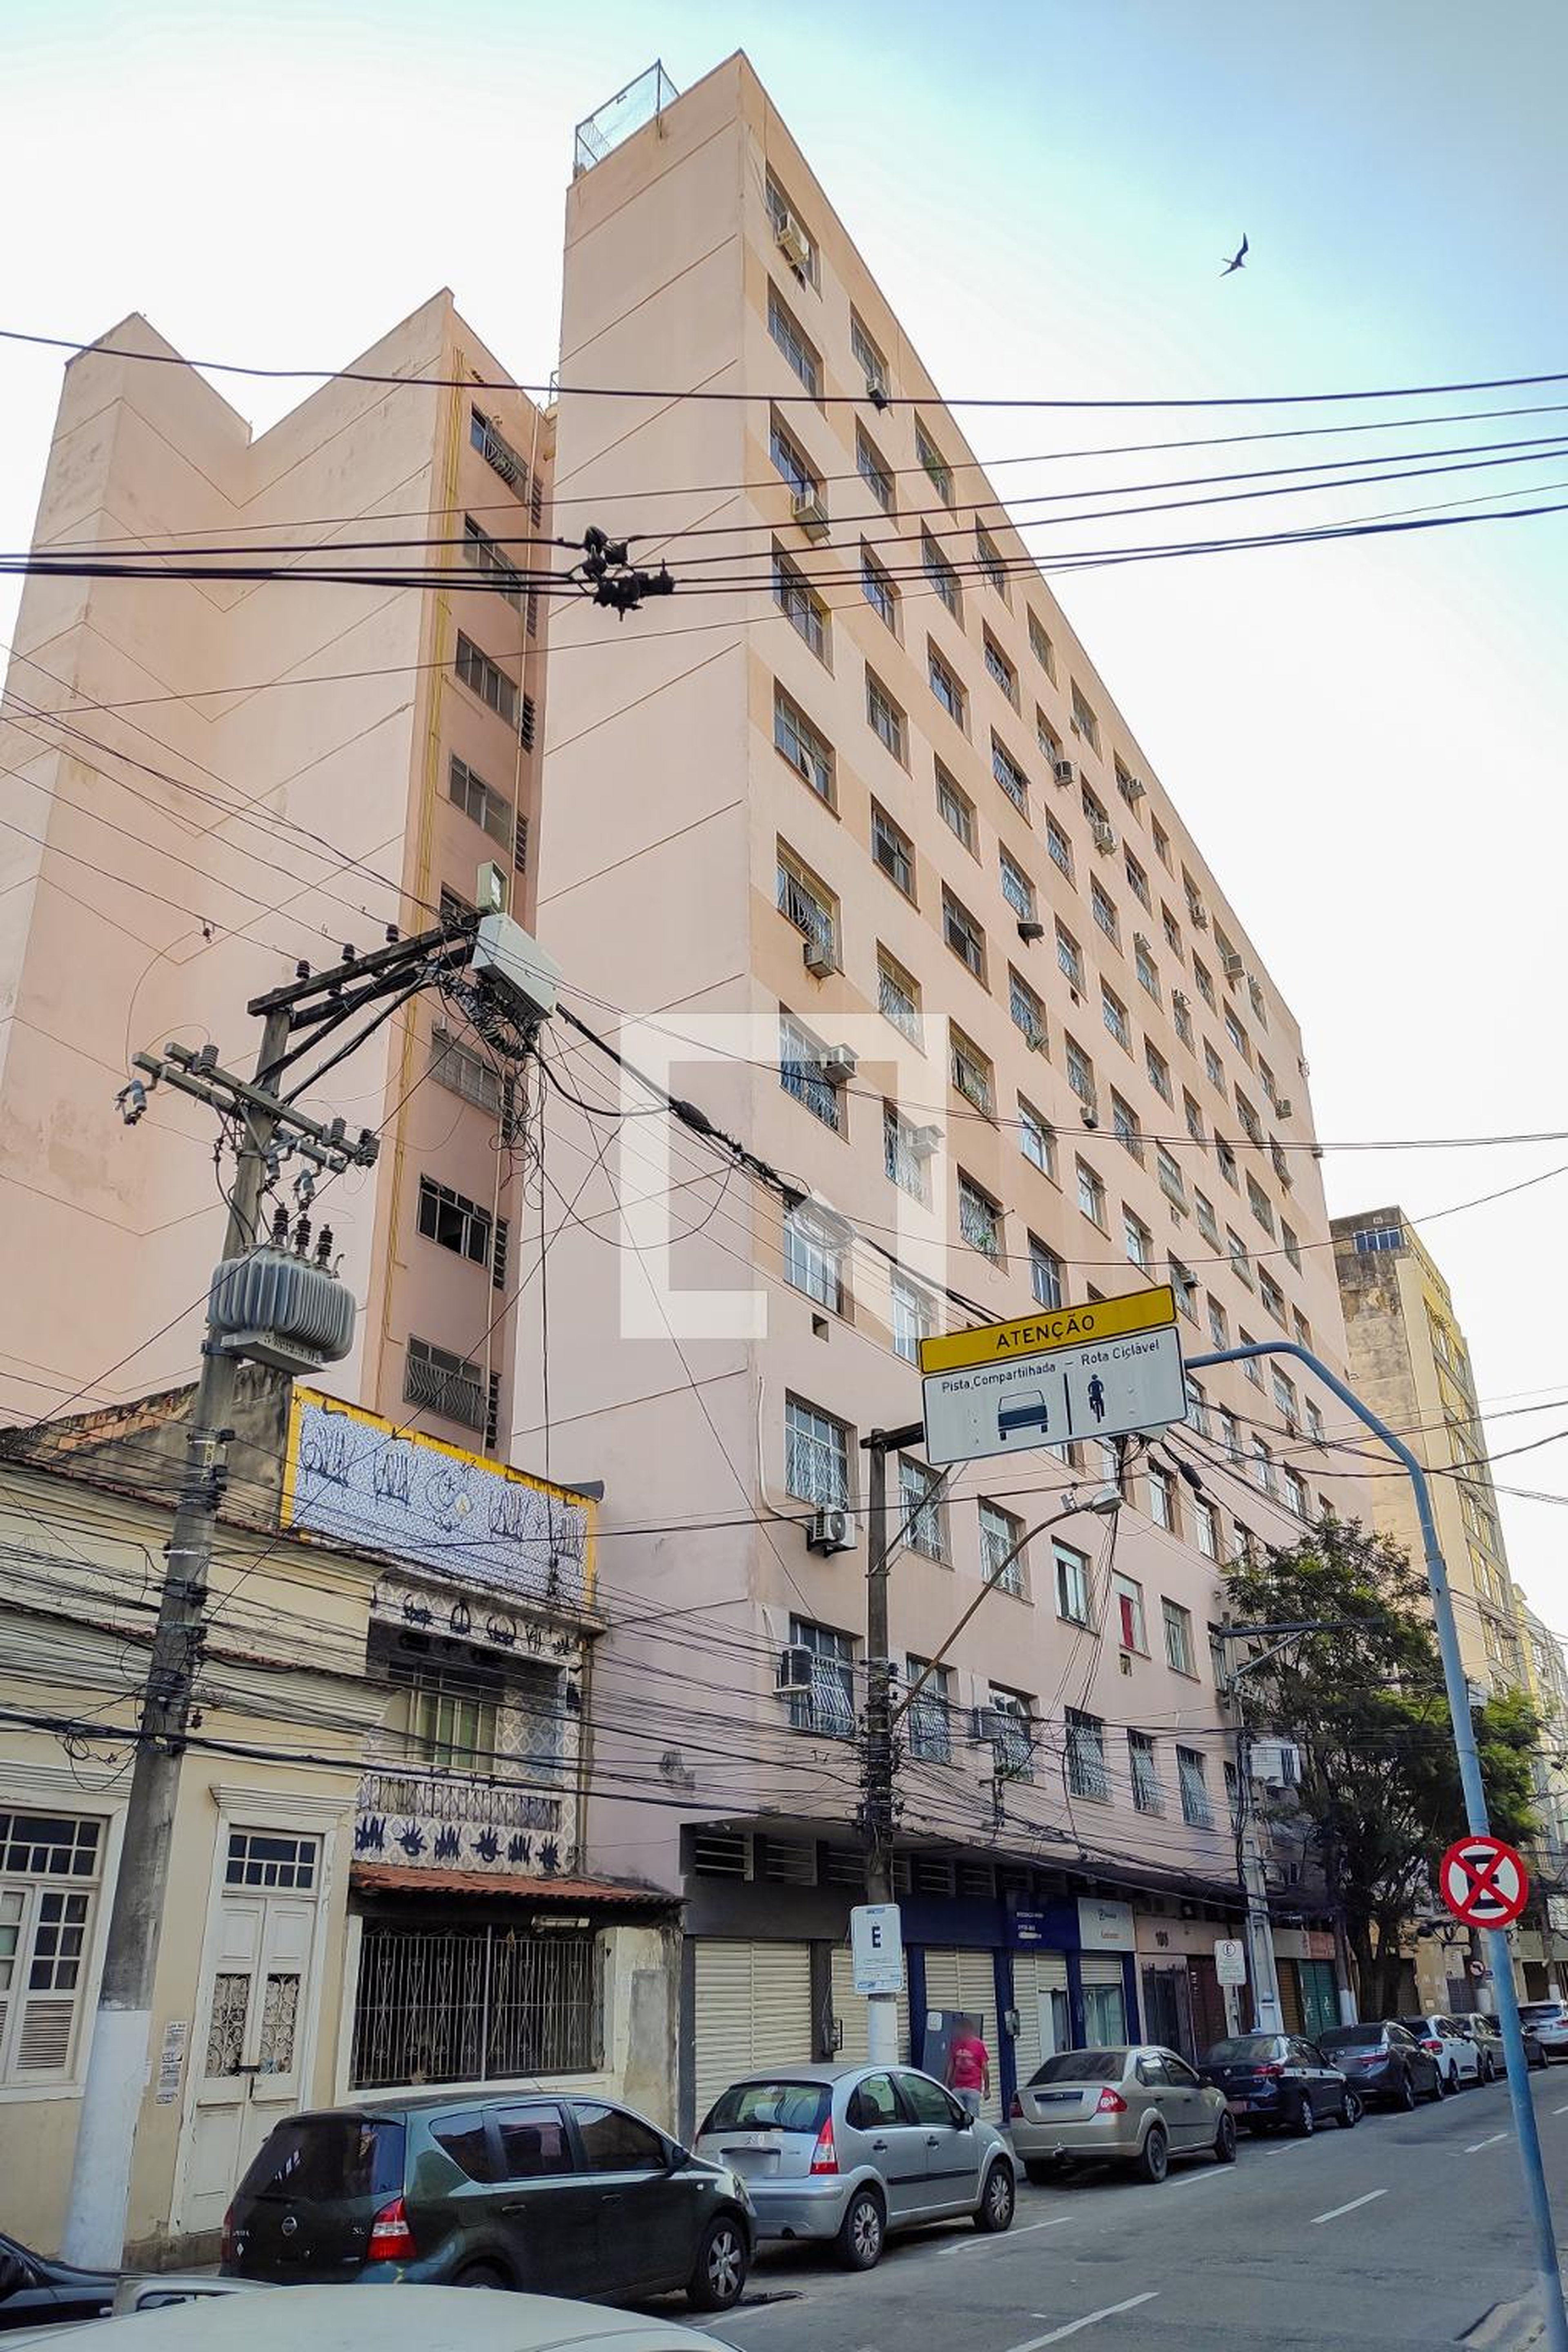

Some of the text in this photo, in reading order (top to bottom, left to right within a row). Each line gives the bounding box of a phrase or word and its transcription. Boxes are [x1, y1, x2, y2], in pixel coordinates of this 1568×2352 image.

[996, 1314, 1094, 1349] ATENÇÃO
[942, 1380, 970, 1393] Pista
[973, 1362, 1056, 1387] Compartilhada
[1081, 1352, 1109, 1366] Rota
[872, 1926, 881, 1948] E
